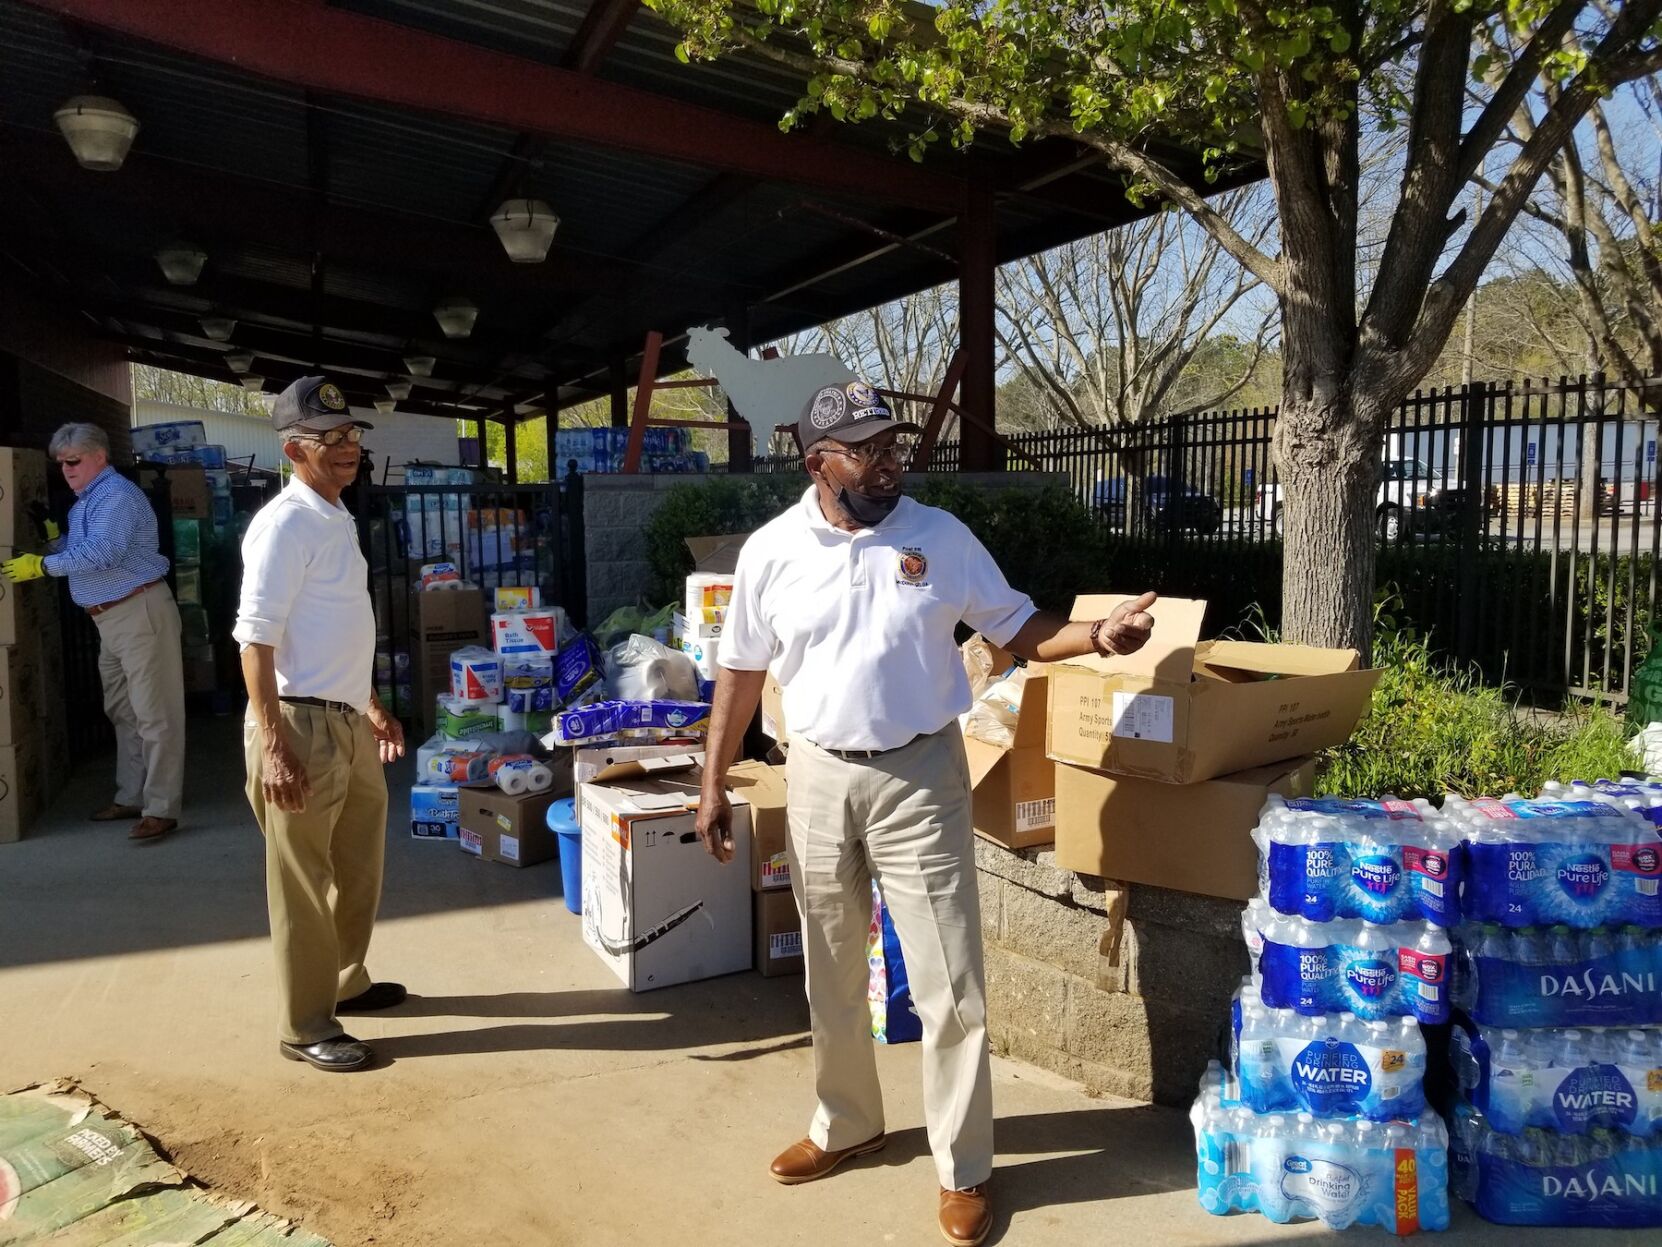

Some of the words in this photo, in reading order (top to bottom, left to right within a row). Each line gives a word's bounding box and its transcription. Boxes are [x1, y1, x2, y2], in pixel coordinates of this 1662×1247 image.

[1080, 696, 1090, 706] PPI
[1091, 698, 1101, 708] 107
[1079, 712, 1093, 725] Army
[1094, 714, 1112, 726] Sports
[1306, 850, 1333, 860] 100%
[1509, 852, 1535, 860] 100%
[1306, 860, 1333, 869] PURE
[1306, 864, 1345, 877] QUALITY
[1509, 862, 1536, 870] PURA
[1352, 868, 1381, 882] Pure
[1383, 872, 1400, 886] Life
[1508, 868, 1546, 880] CALIDAD
[1558, 870, 1589, 882] Pure
[1592, 872, 1608, 886] Life
[1509, 904, 1522, 912] 24
[1300, 955, 1328, 964] 100%
[1300, 963, 1327, 972] PURE
[1300, 967, 1339, 980] QUALITY
[1347, 970, 1376, 985] Pure
[1377, 974, 1395, 987] Life
[1541, 968, 1655, 1000] DASANI
[1307, 1050, 1358, 1062] PURIFIED
[1391, 1055, 1404, 1064] 24
[1306, 1058, 1359, 1068] DRINKING
[1296, 1062, 1368, 1085] WATER
[1559, 1091, 1632, 1109] WATER
[1398, 1159, 1415, 1172] 40
[1309, 1177, 1350, 1190] Drinking
[1543, 1169, 1656, 1202] DASANI
[1321, 1186, 1350, 1199] Water
[1398, 1189, 1408, 1219] PACK
[1408, 1185, 1417, 1219] VALUE
